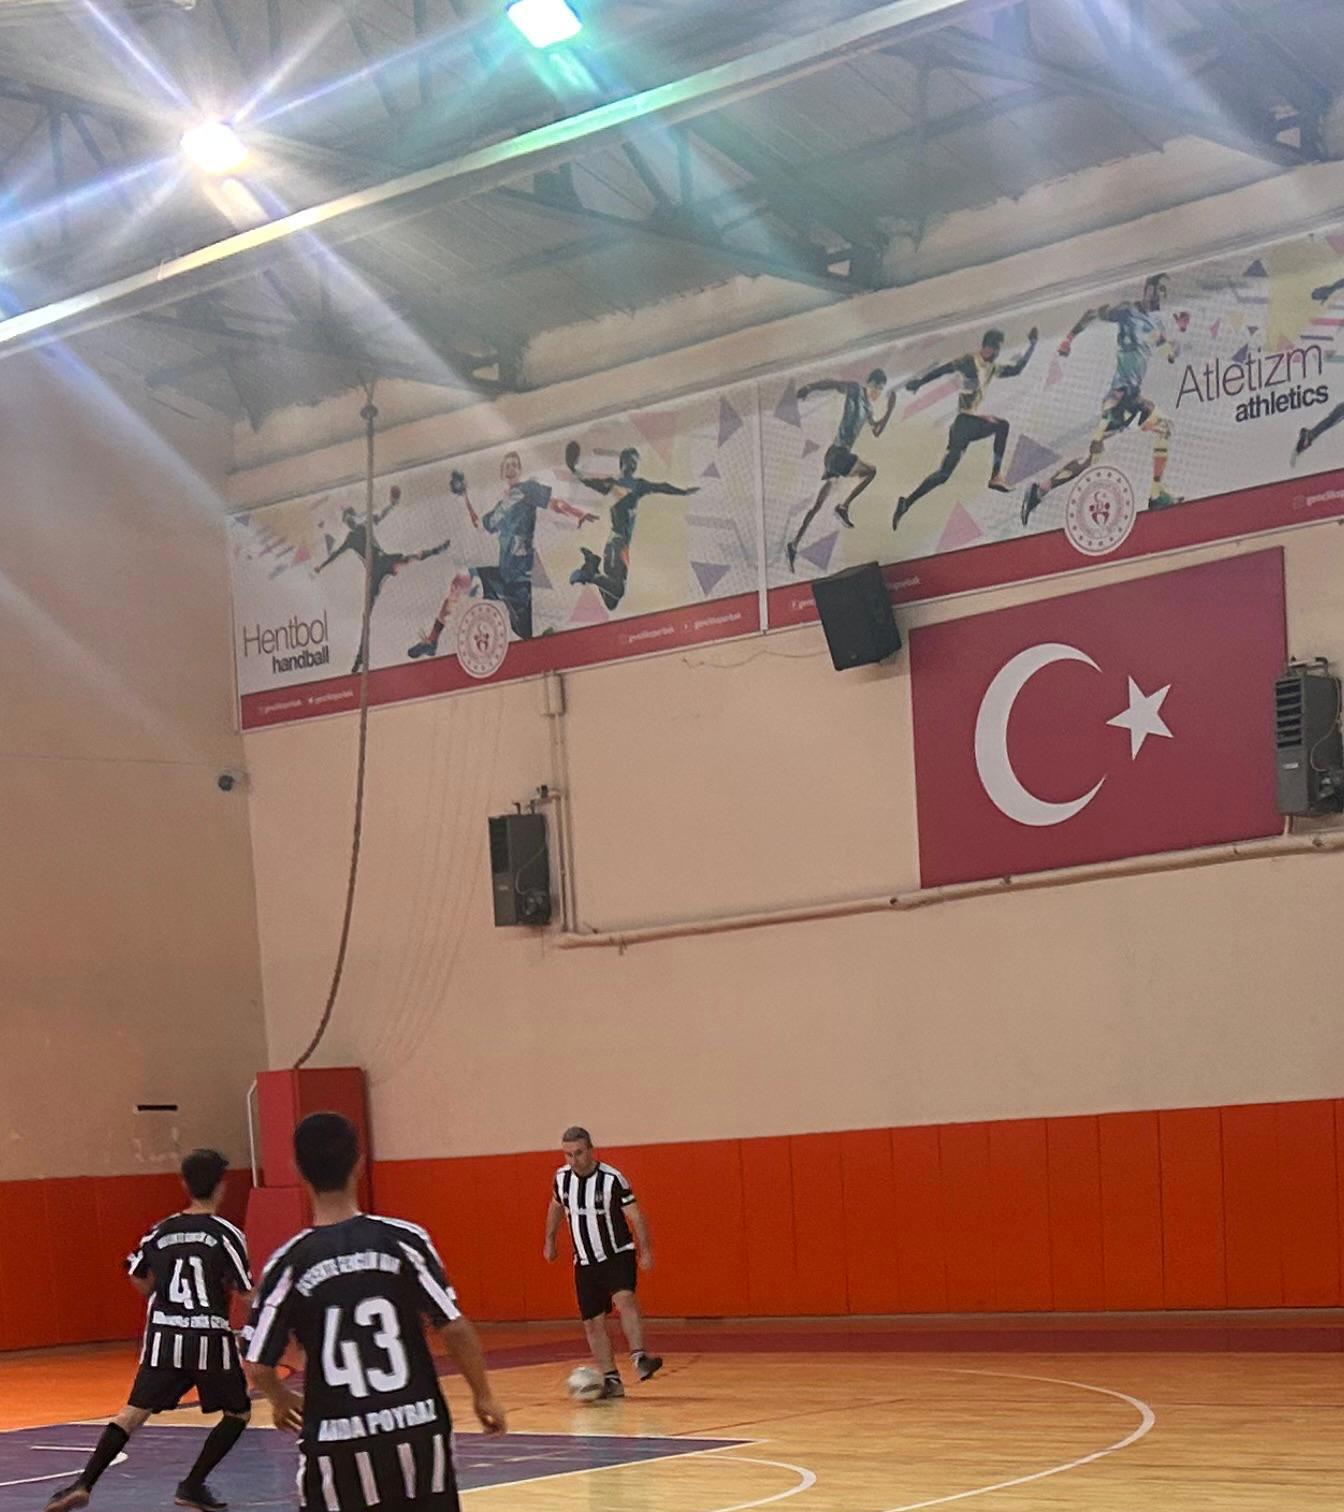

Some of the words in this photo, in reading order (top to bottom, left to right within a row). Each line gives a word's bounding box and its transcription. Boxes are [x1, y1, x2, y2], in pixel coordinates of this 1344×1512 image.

[1175, 342, 1324, 409] Atletizm
[1234, 382, 1329, 424] athletics
[243, 610, 330, 657] Hentbol
[272, 648, 330, 675] handball
[169, 1256, 210, 1309] 41
[322, 1296, 409, 1397] 43
